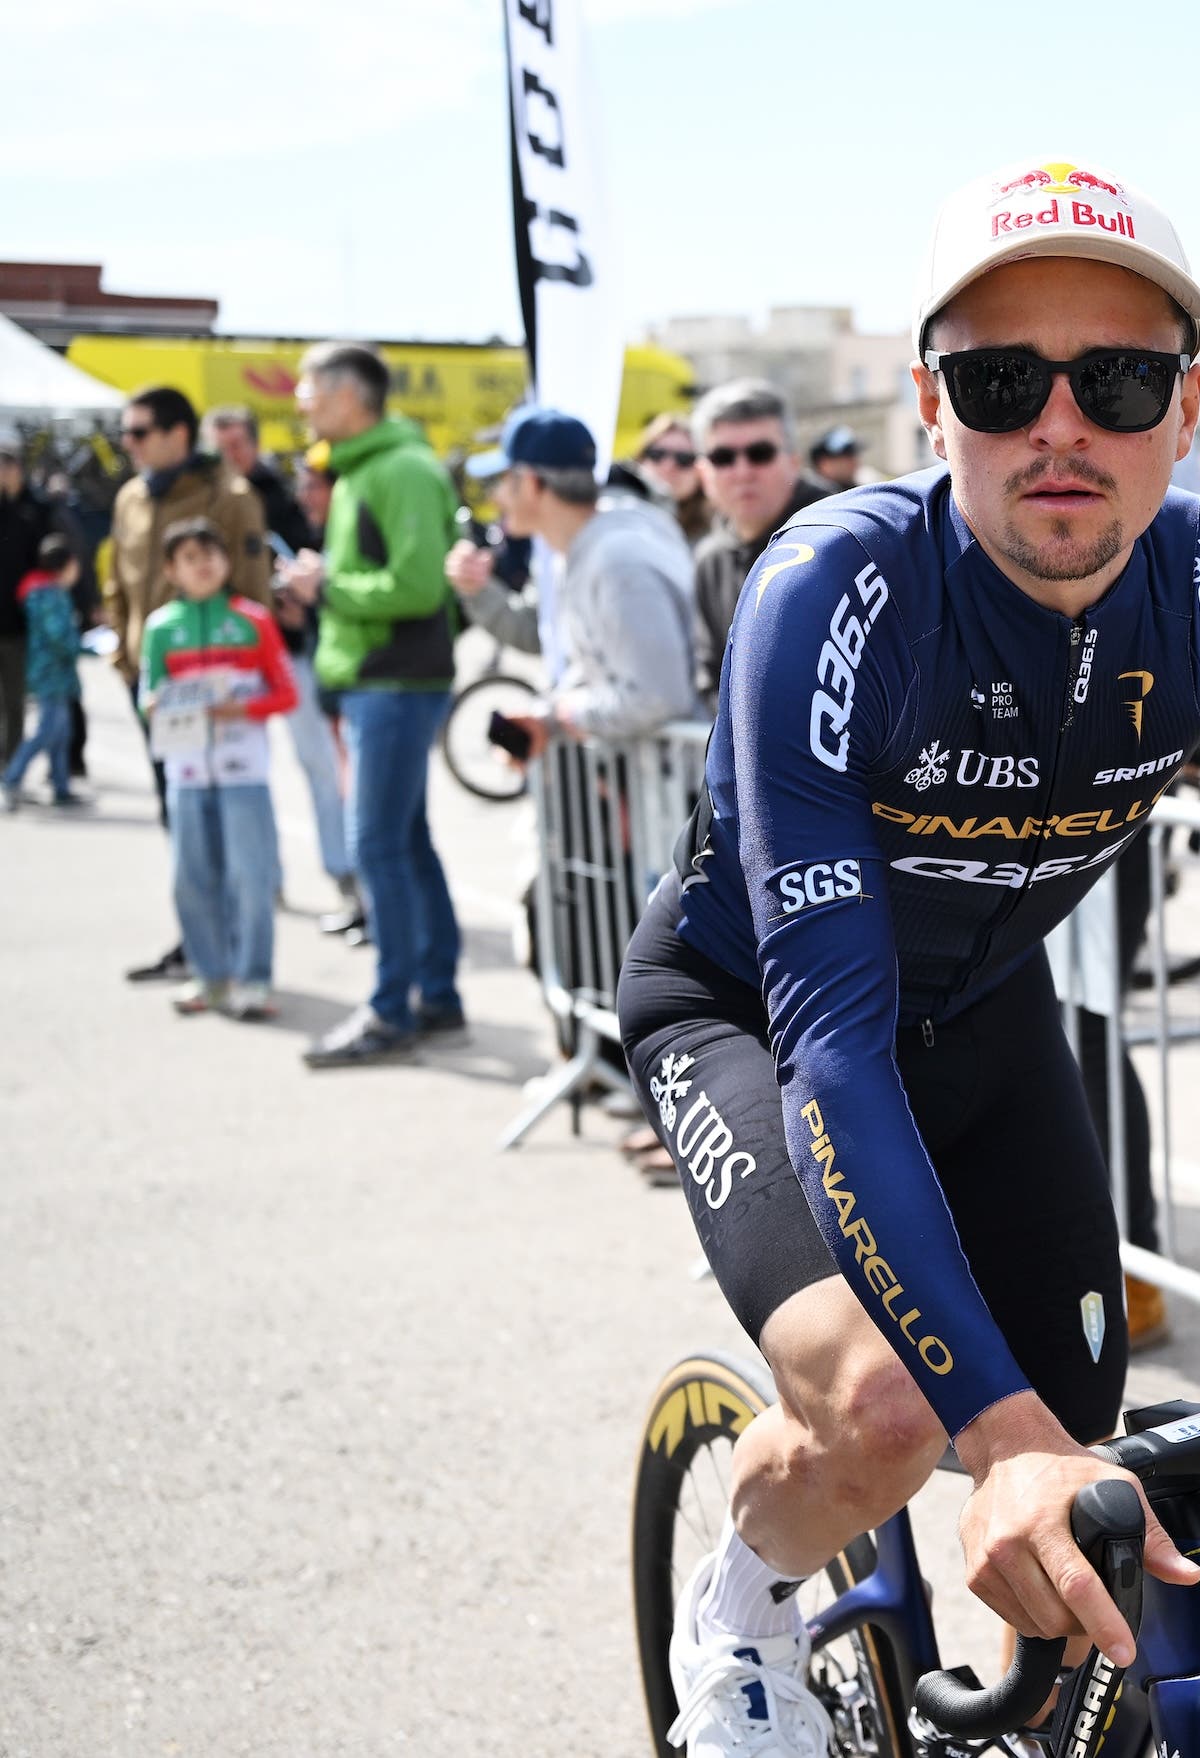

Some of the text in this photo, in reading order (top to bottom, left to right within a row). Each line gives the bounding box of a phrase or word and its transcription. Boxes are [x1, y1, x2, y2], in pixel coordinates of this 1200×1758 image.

[992, 199, 1136, 239] Red Bull
[809, 561, 889, 773] Q36.5
[1073, 628, 1098, 704] Q36.5
[991, 682, 1013, 694] UCI
[991, 694, 1013, 707] PRO
[991, 706, 1019, 719] TEAM
[956, 749, 1040, 788] UBS
[1092, 749, 1184, 786] SRAM
[779, 859, 861, 914] SGS
[676, 1090, 757, 1211] UBS
